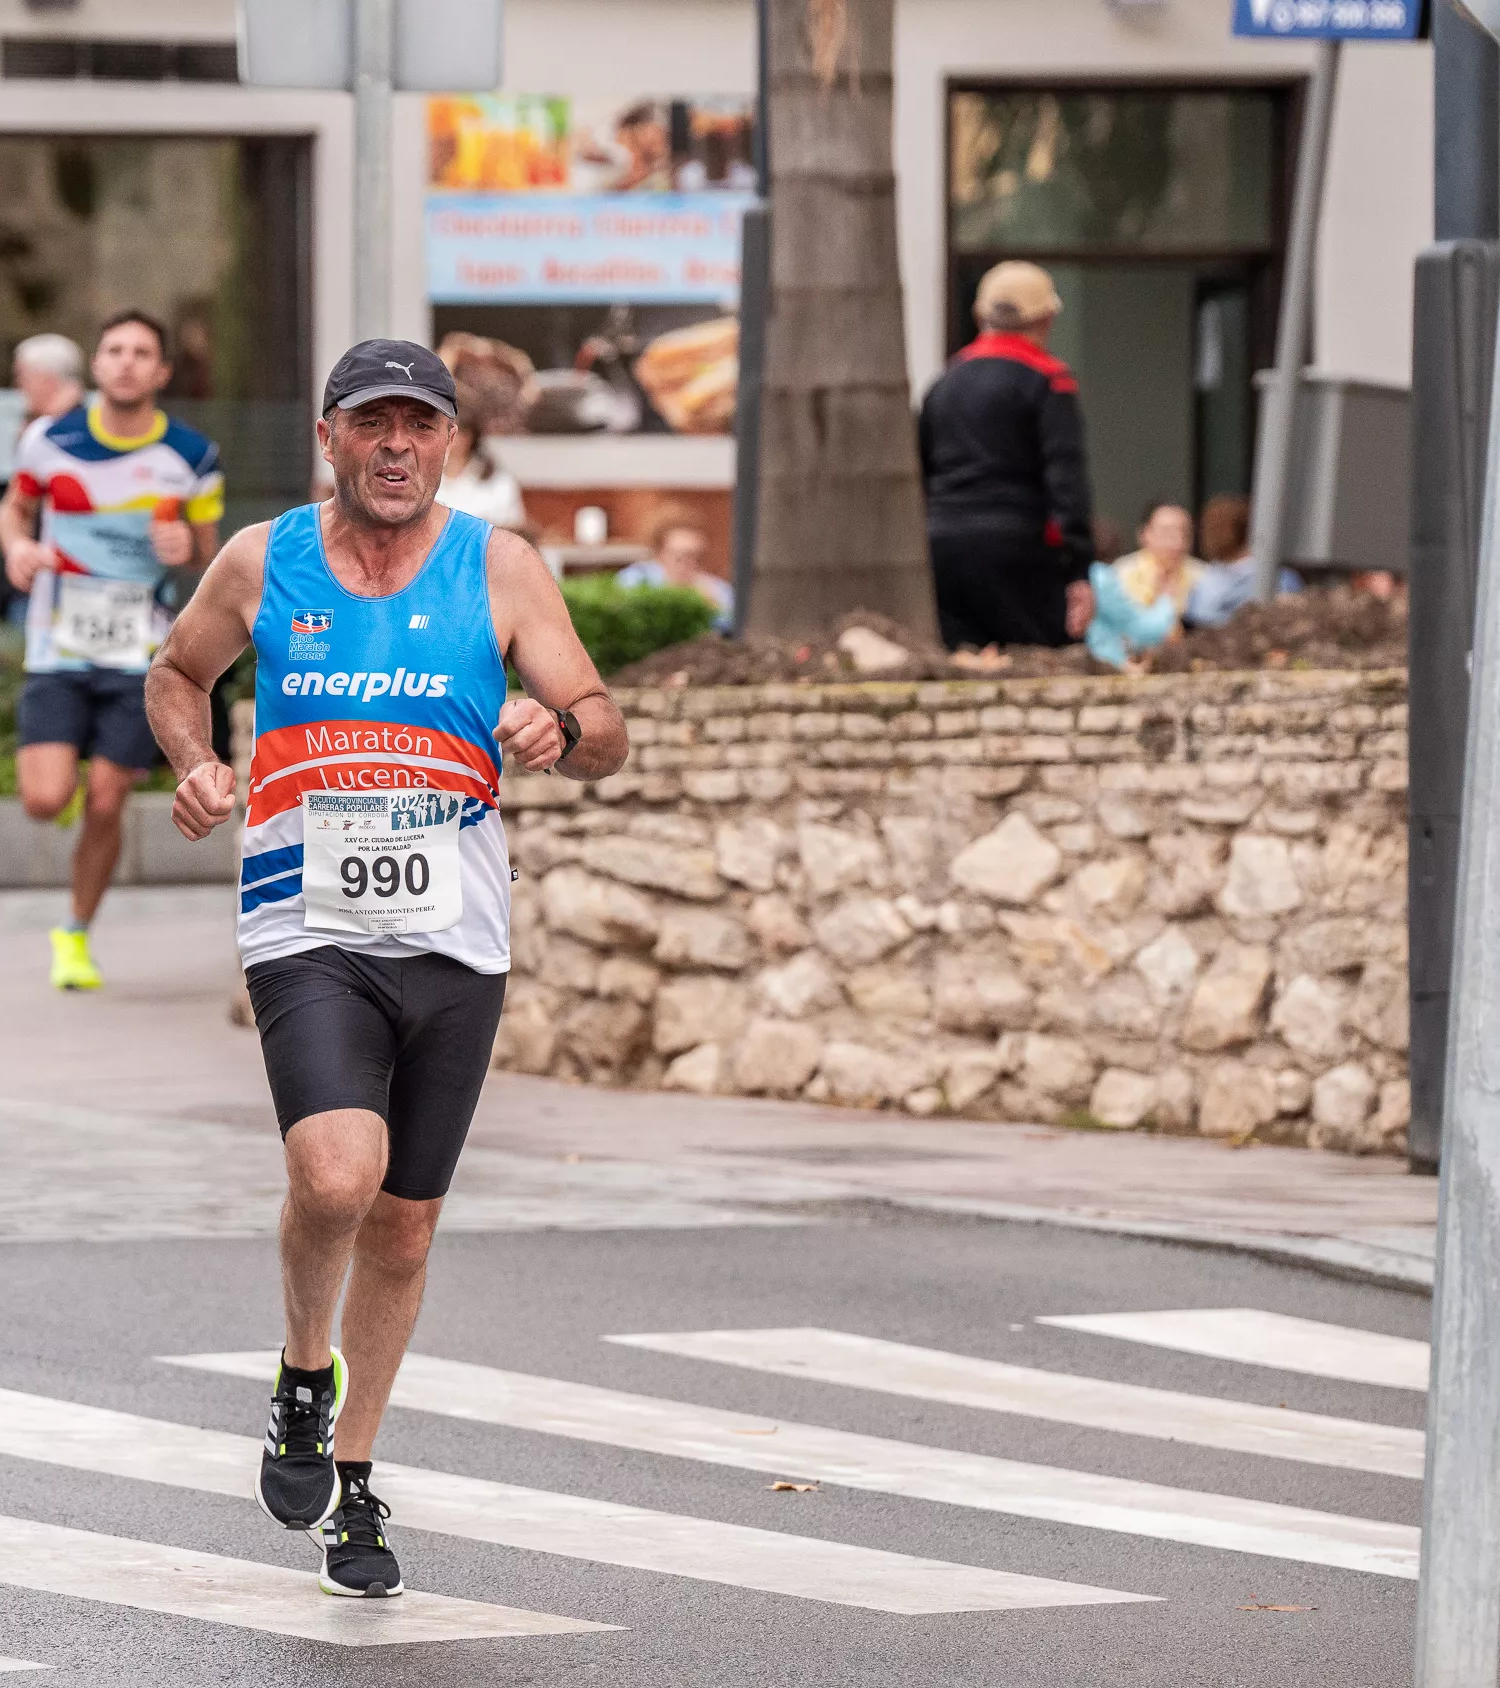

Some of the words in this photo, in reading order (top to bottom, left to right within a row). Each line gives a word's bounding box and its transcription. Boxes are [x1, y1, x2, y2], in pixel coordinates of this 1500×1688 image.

[290, 633, 314, 643] Club
[289, 641, 331, 651] Maratón
[289, 650, 326, 660] Lucena
[282, 667, 449, 703] enerplus
[305, 726, 433, 756] Maratón
[319, 767, 428, 790] Lucena
[308, 796, 337, 804] CIRCUITO
[339, 797, 378, 805] PROVINCIAL
[390, 793, 429, 812] 2024
[308, 803, 344, 812] CARRERAS
[346, 804, 389, 812] POPULARES
[403, 834, 425, 842] LUCENA
[340, 852, 430, 899] 990
[386, 907, 414, 915] MONTES
